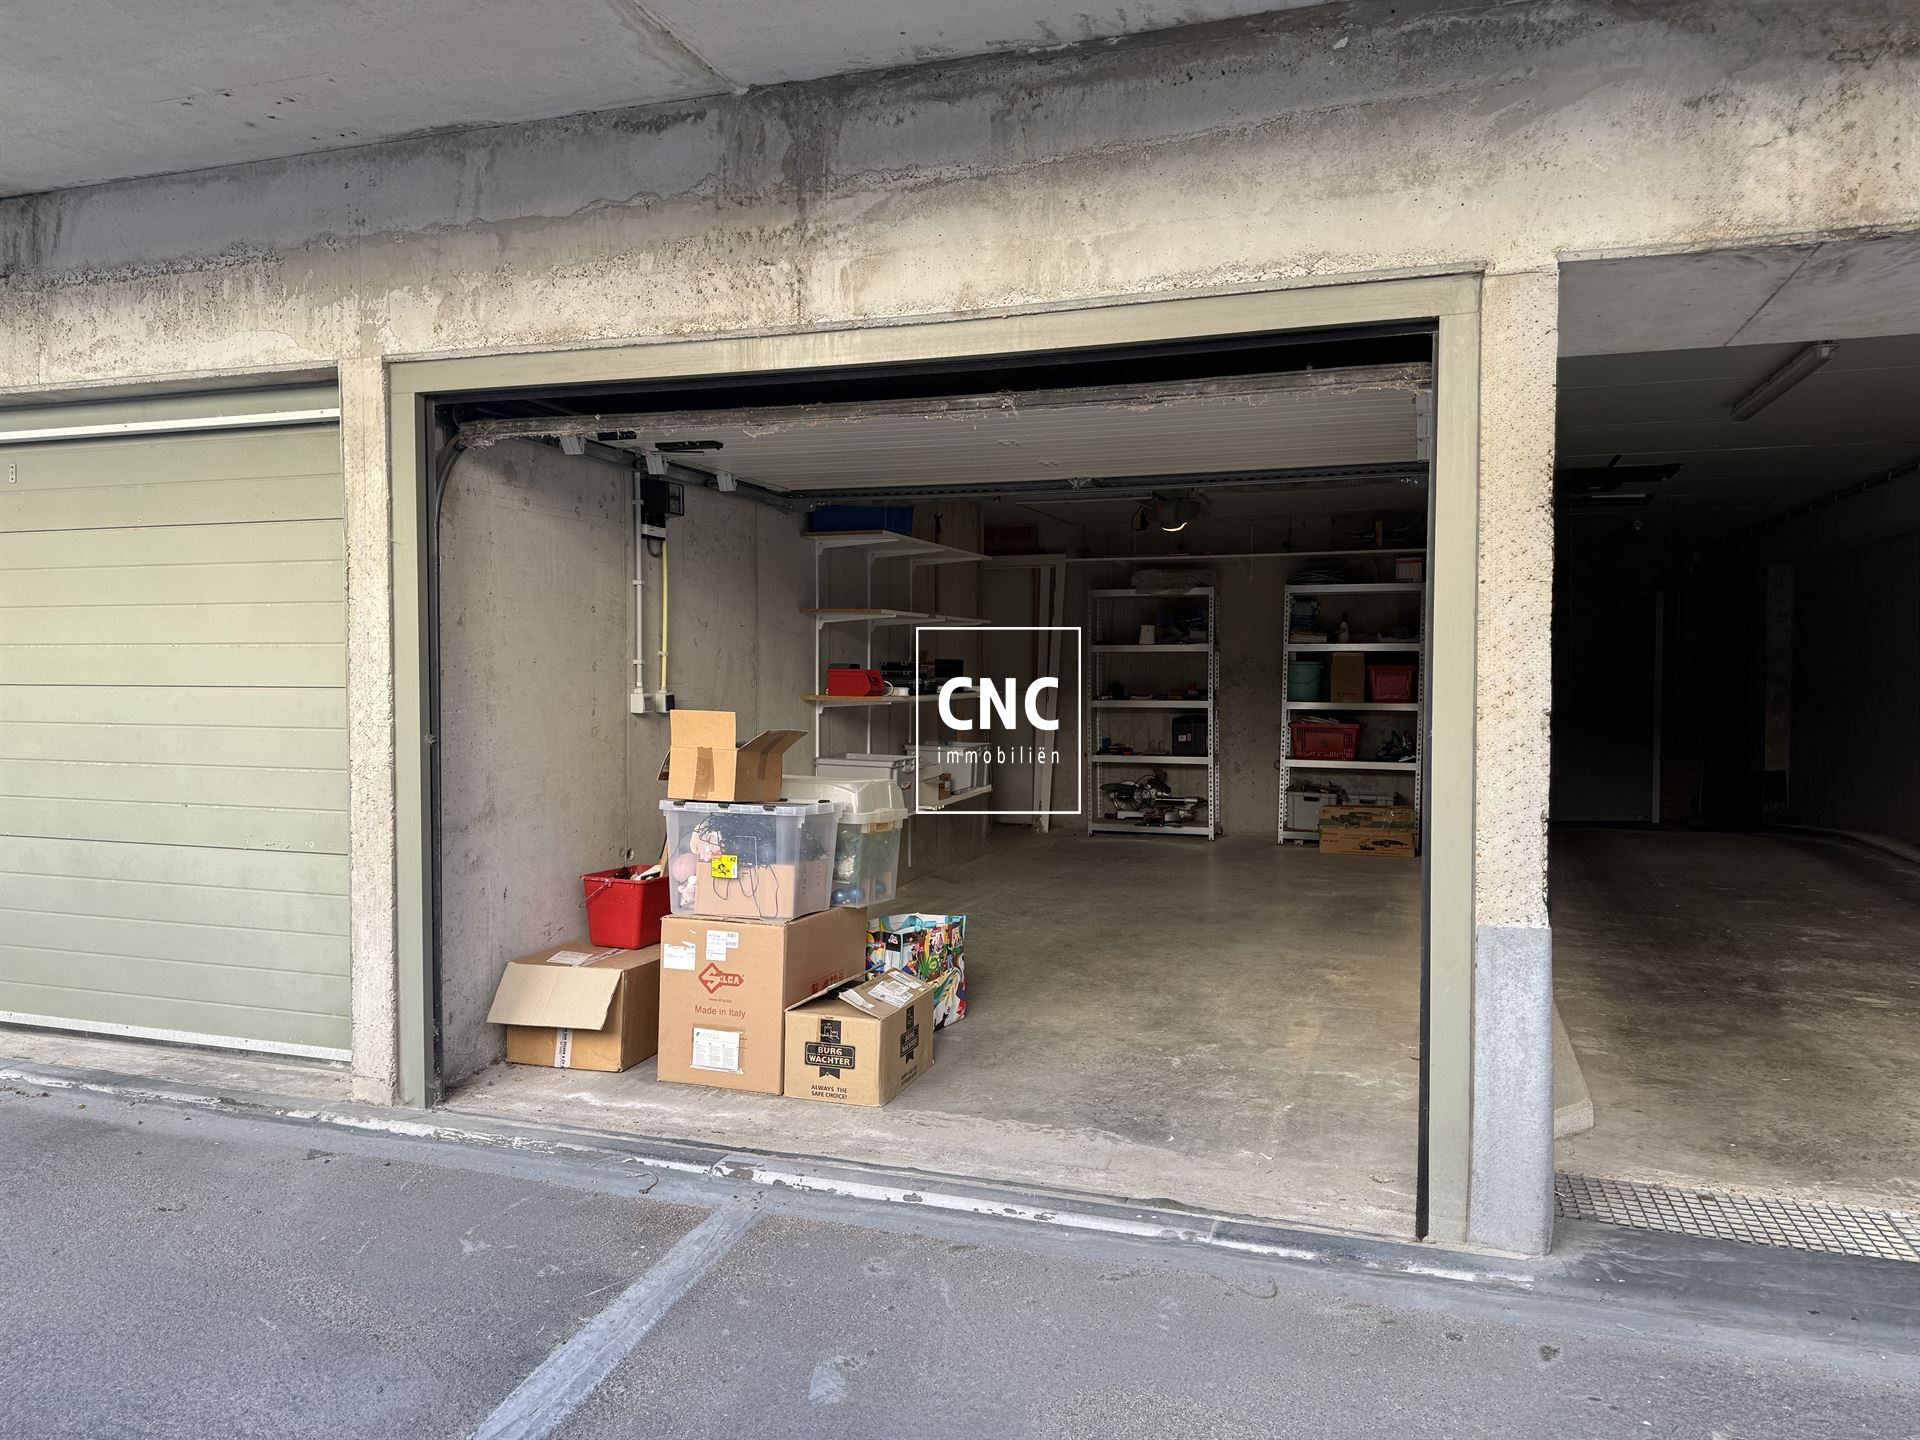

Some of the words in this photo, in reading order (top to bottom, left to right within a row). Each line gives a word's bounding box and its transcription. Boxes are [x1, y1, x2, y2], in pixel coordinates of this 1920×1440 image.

[694, 1005, 717, 1015] Made
[729, 1008, 746, 1019] Italy
[817, 1046, 842, 1055] BURG
[809, 1053, 850, 1065] WÄCHTER
[811, 1084, 835, 1092] ALWAYS
[825, 1092, 848, 1100] CHOICE!
